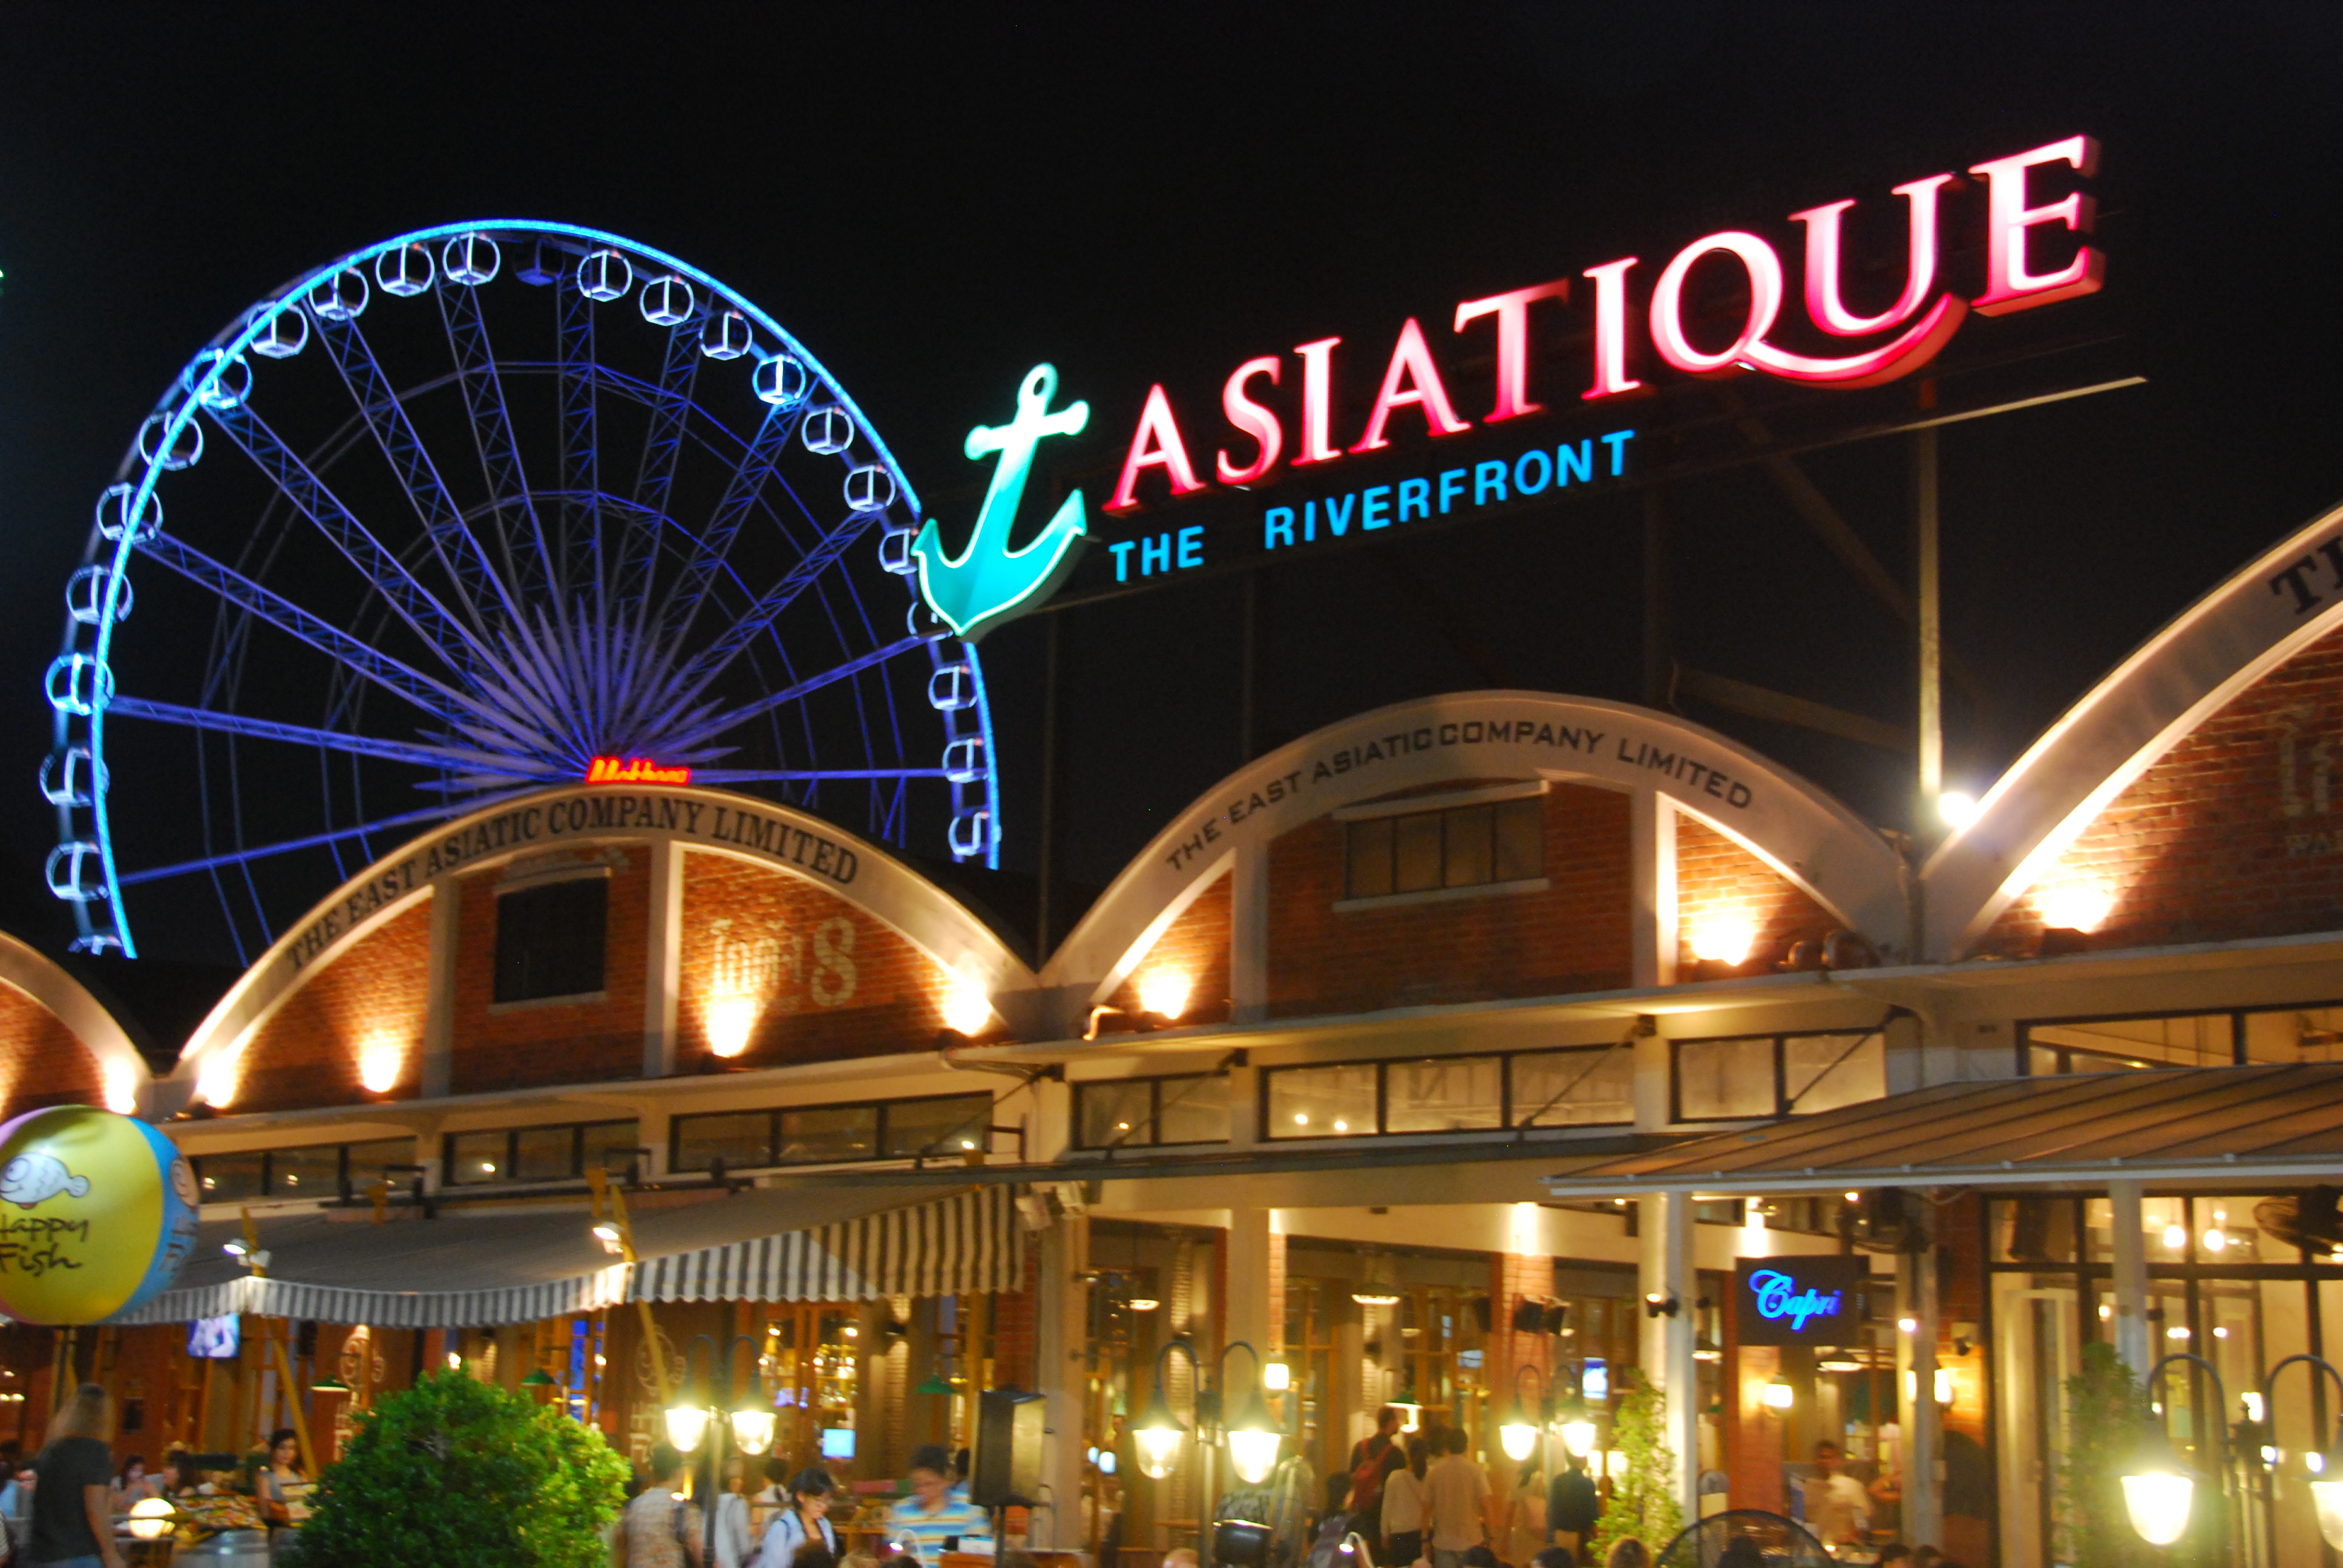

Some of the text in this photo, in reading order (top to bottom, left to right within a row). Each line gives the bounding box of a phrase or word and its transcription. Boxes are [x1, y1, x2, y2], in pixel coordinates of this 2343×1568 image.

[1103, 134, 2103, 514] ASIATIQUE
[1109, 430, 1637, 583] THE RIVERFRONT
[1166, 720, 1752, 871] THE EAST ASIATIC COMPANY LIMITED
[287, 796, 858, 969] THE EAST ASIATIC COMPANY LIMITED
[811, 916, 857, 1007] 8
[1748, 1269, 1843, 1332] Capri
